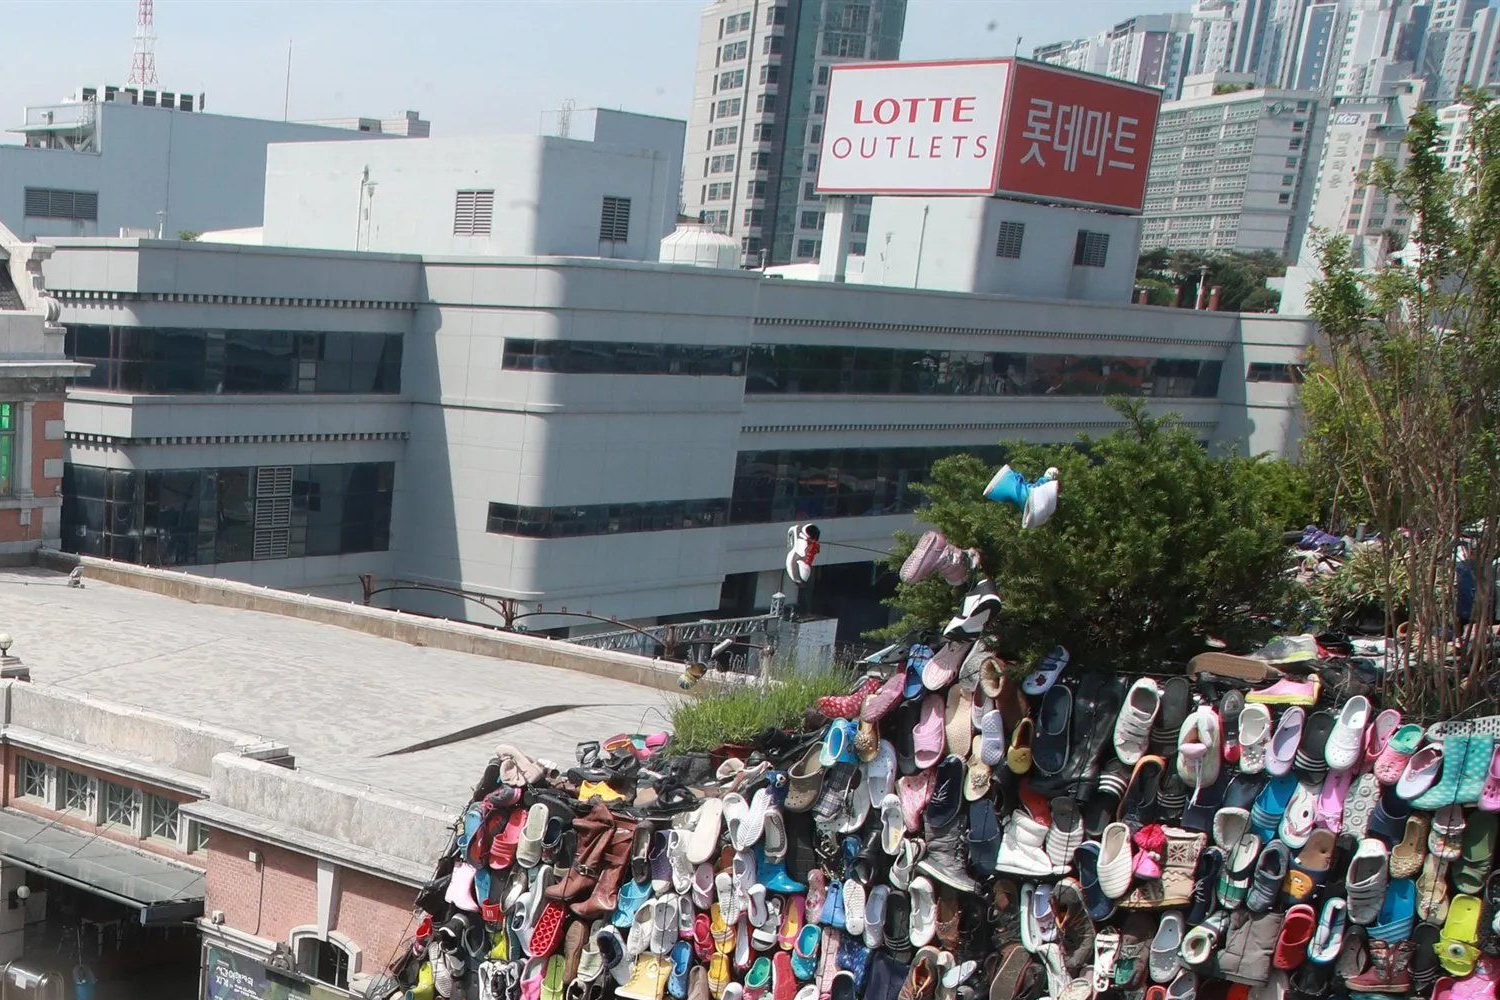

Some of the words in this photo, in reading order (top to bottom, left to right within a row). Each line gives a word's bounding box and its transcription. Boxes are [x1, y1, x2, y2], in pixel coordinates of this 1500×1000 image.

[853, 97, 977, 125] LOTTE
[832, 134, 988, 160] OUTLETS
[1020, 98, 1139, 176] 롯데마트
